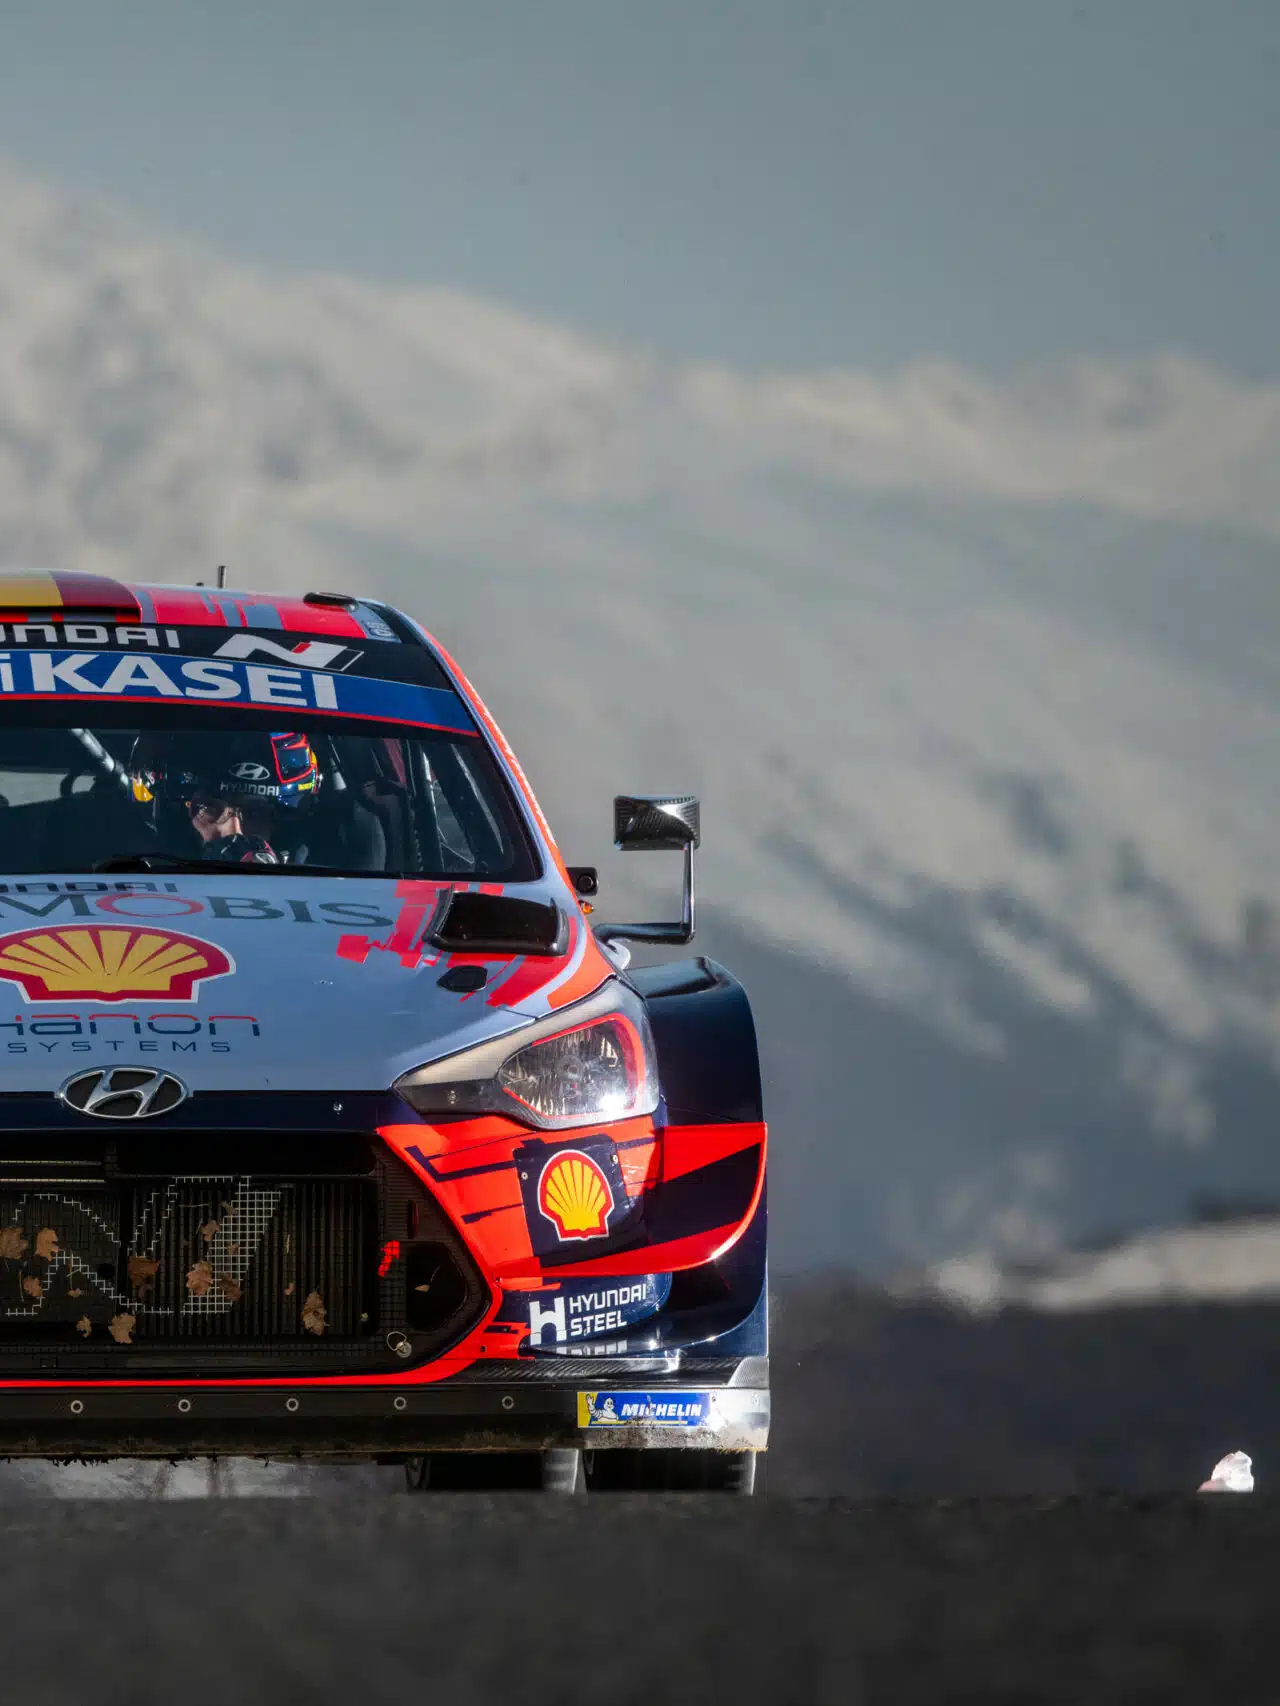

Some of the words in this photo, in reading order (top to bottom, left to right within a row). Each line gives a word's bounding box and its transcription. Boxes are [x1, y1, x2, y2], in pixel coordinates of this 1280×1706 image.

[221, 781, 280, 797] HYUNDAI
[7, 1040, 232, 1054] SYSTEMS
[569, 1283, 647, 1315] HYUNDAI
[569, 1309, 628, 1338] STEEL
[621, 1403, 702, 1418] MICHELIN
